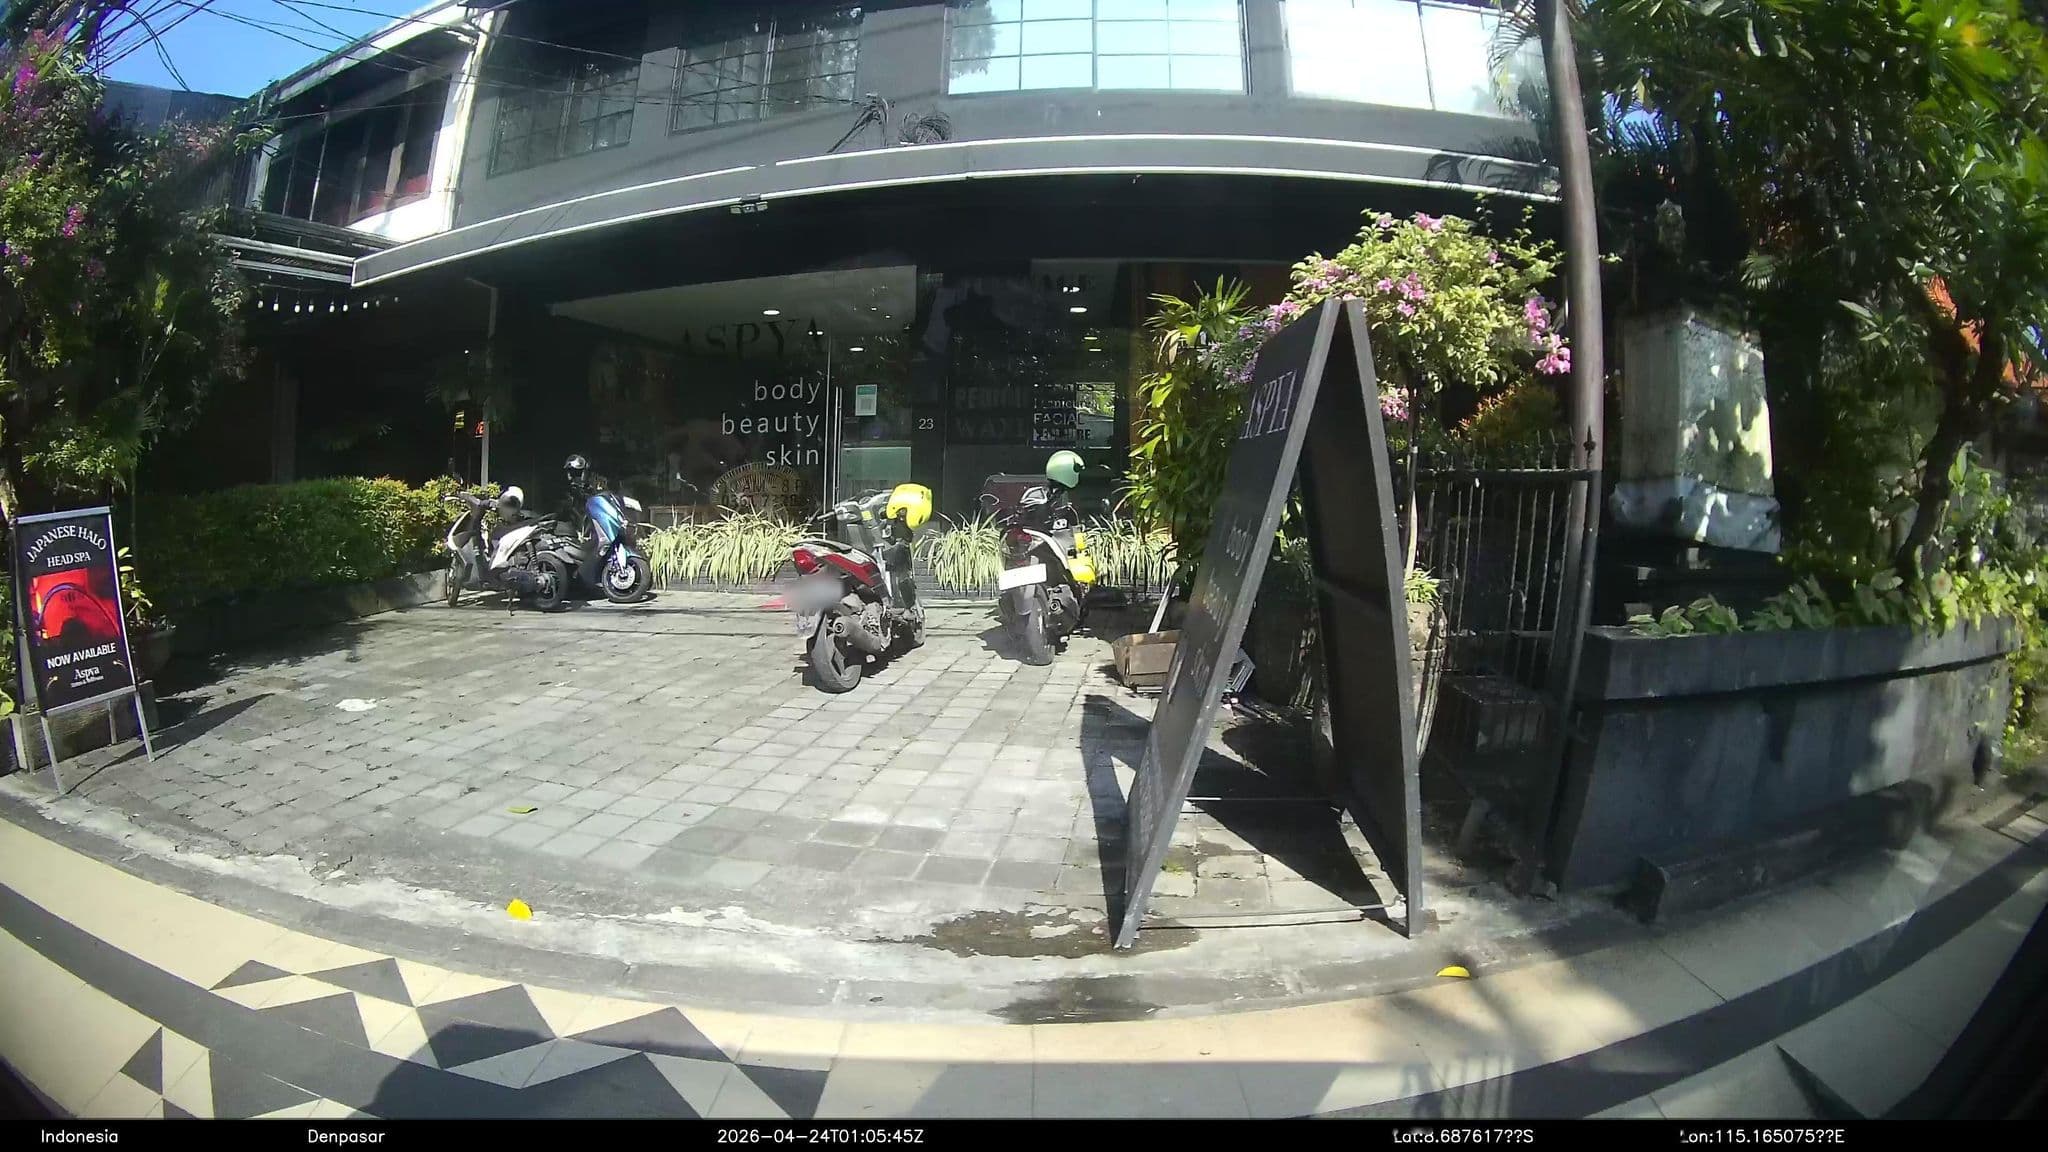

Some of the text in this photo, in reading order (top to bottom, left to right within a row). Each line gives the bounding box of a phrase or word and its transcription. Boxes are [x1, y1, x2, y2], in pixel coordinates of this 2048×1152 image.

[754, 376, 820, 404] body
[1238, 368, 1298, 440] ASPYA
[722, 411, 820, 438] beauty
[917, 418, 935, 431] 23
[1033, 412, 1086, 425] FACIAL
[766, 443, 819, 466] skin
[27, 525, 107, 563] JAPANESE HALO
[47, 551, 92, 568] HEAD SPA
[46, 642, 117, 669] NOW AVAILABLE
